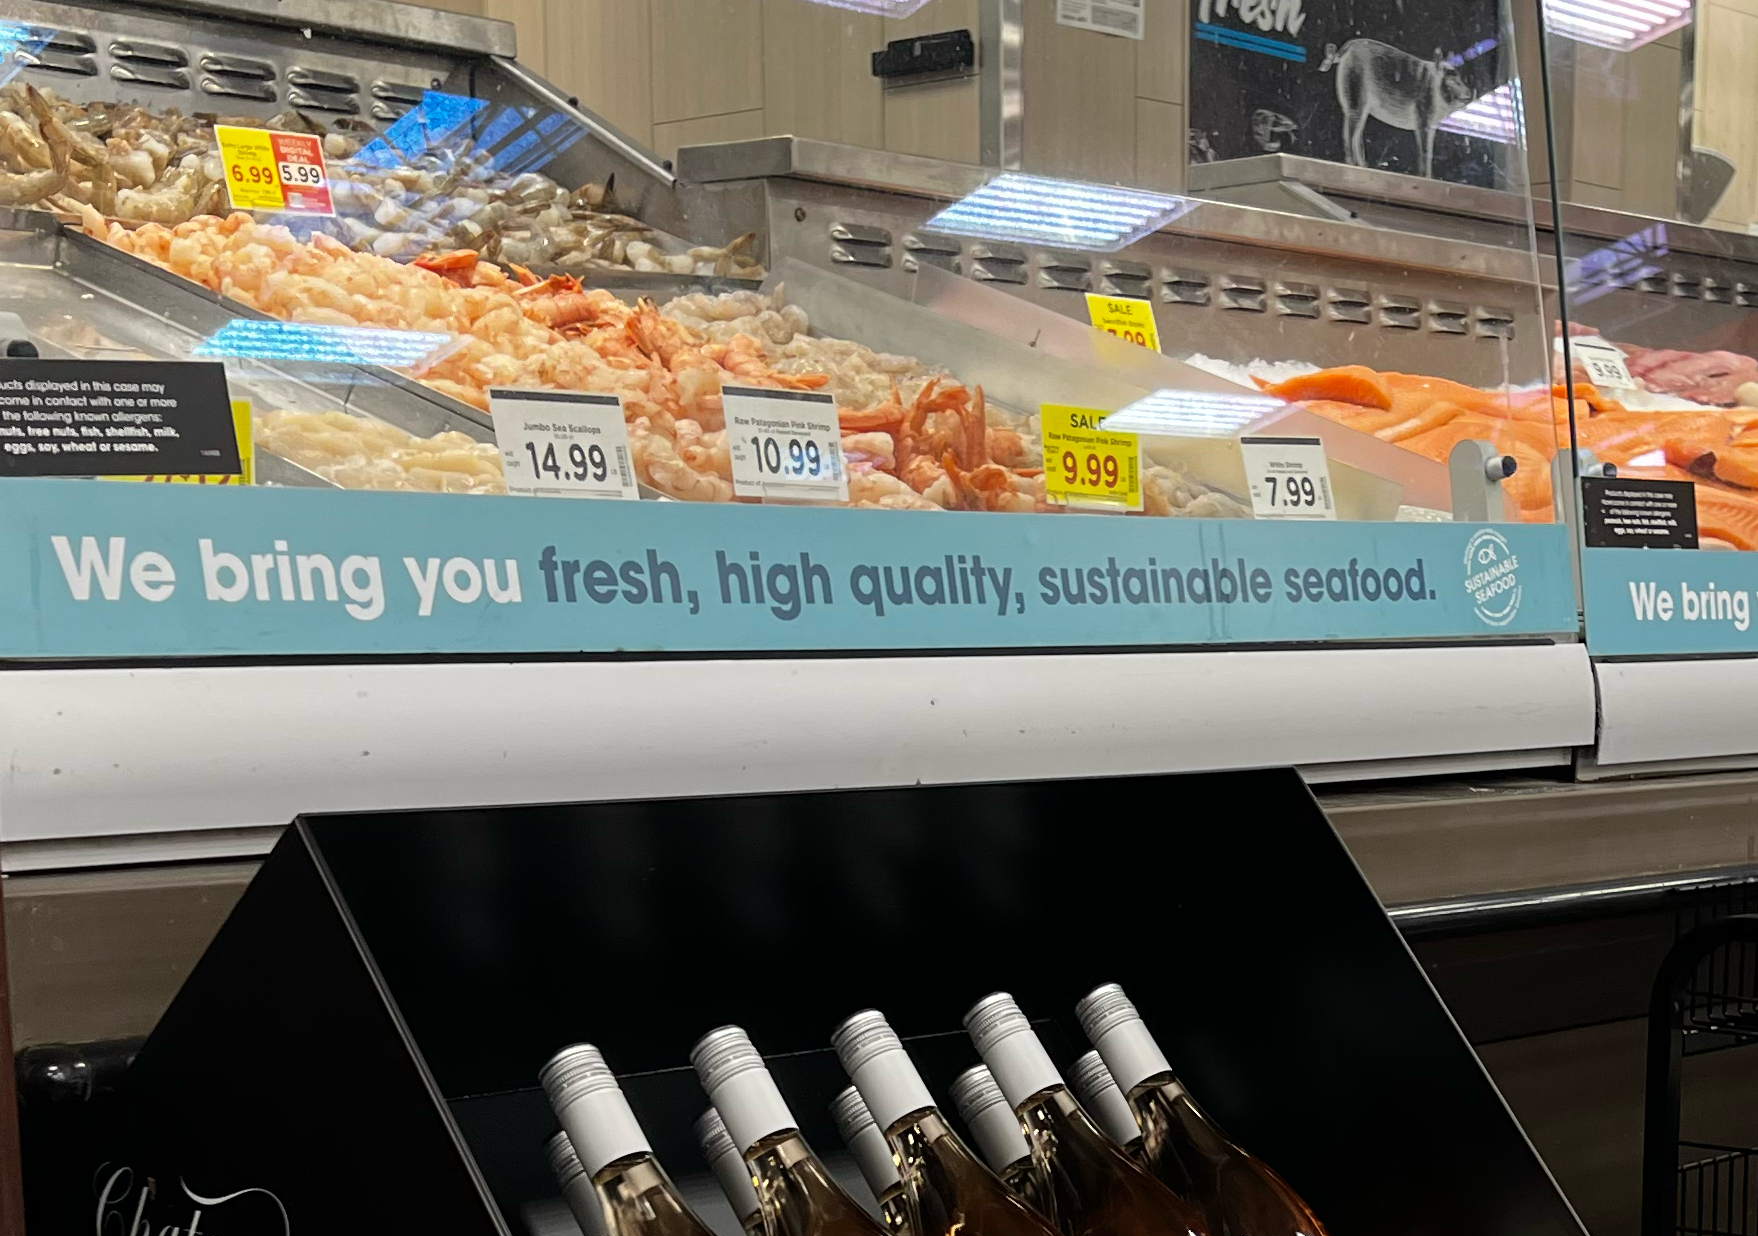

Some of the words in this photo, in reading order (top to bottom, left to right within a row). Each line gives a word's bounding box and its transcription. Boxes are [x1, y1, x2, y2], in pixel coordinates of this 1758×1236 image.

[232, 164, 274, 185] 6.99
[281, 164, 320, 184] 5.99
[1107, 302, 1134, 315] SALE
[25, 380, 79, 393] displayed
[80, 381, 91, 391] in
[92, 381, 112, 391] this
[113, 383, 140, 392] case
[141, 383, 165, 394] may
[31, 395, 44, 406] in
[45, 395, 87, 407] contact
[88, 395, 112, 407] with
[113, 398, 135, 407] one
[136, 398, 148, 407] or
[149, 398, 178, 408] more
[2, 410, 21, 421] the
[23, 410, 73, 424] following
[74, 410, 110, 422] known
[735, 416, 750, 425] Raw
[751, 417, 790, 429] Patagonian
[791, 420, 806, 429] Pink
[807, 422, 831, 432] Shrimp
[27, 425, 51, 437] tree
[52, 426, 80, 438] nuts,
[80, 425, 104, 438] fish,
[153, 426, 180, 438] milk,
[524, 421, 550, 432] Jumbo
[552, 423, 567, 432] Sea
[568, 424, 602, 435] Scallops
[4, 442, 37, 455] eggs,
[37, 442, 61, 454] soy,
[61, 441, 98, 453] wheat
[99, 442, 111, 453] or
[112, 442, 159, 453] sesame.
[751, 436, 821, 477] 10.99
[525, 441, 607, 482] 14.99
[1063, 450, 1119, 489] 9.99
[1264, 476, 1315, 507] 7.99
[51, 535, 176, 602] We
[199, 538, 386, 621] bring
[402, 556, 522, 616] you
[538, 545, 699, 615] fresh,
[716, 549, 833, 621] high
[850, 554, 1025, 617] quality,
[1038, 556, 1272, 605] sustainable
[1284, 556, 1437, 603] seafood.
[1465, 555, 1519, 593] SUSTAINABLE
[1475, 573, 1516, 604] SEAFOOD
[1628, 581, 1674, 621] We
[1681, 581, 1750, 632] bring
